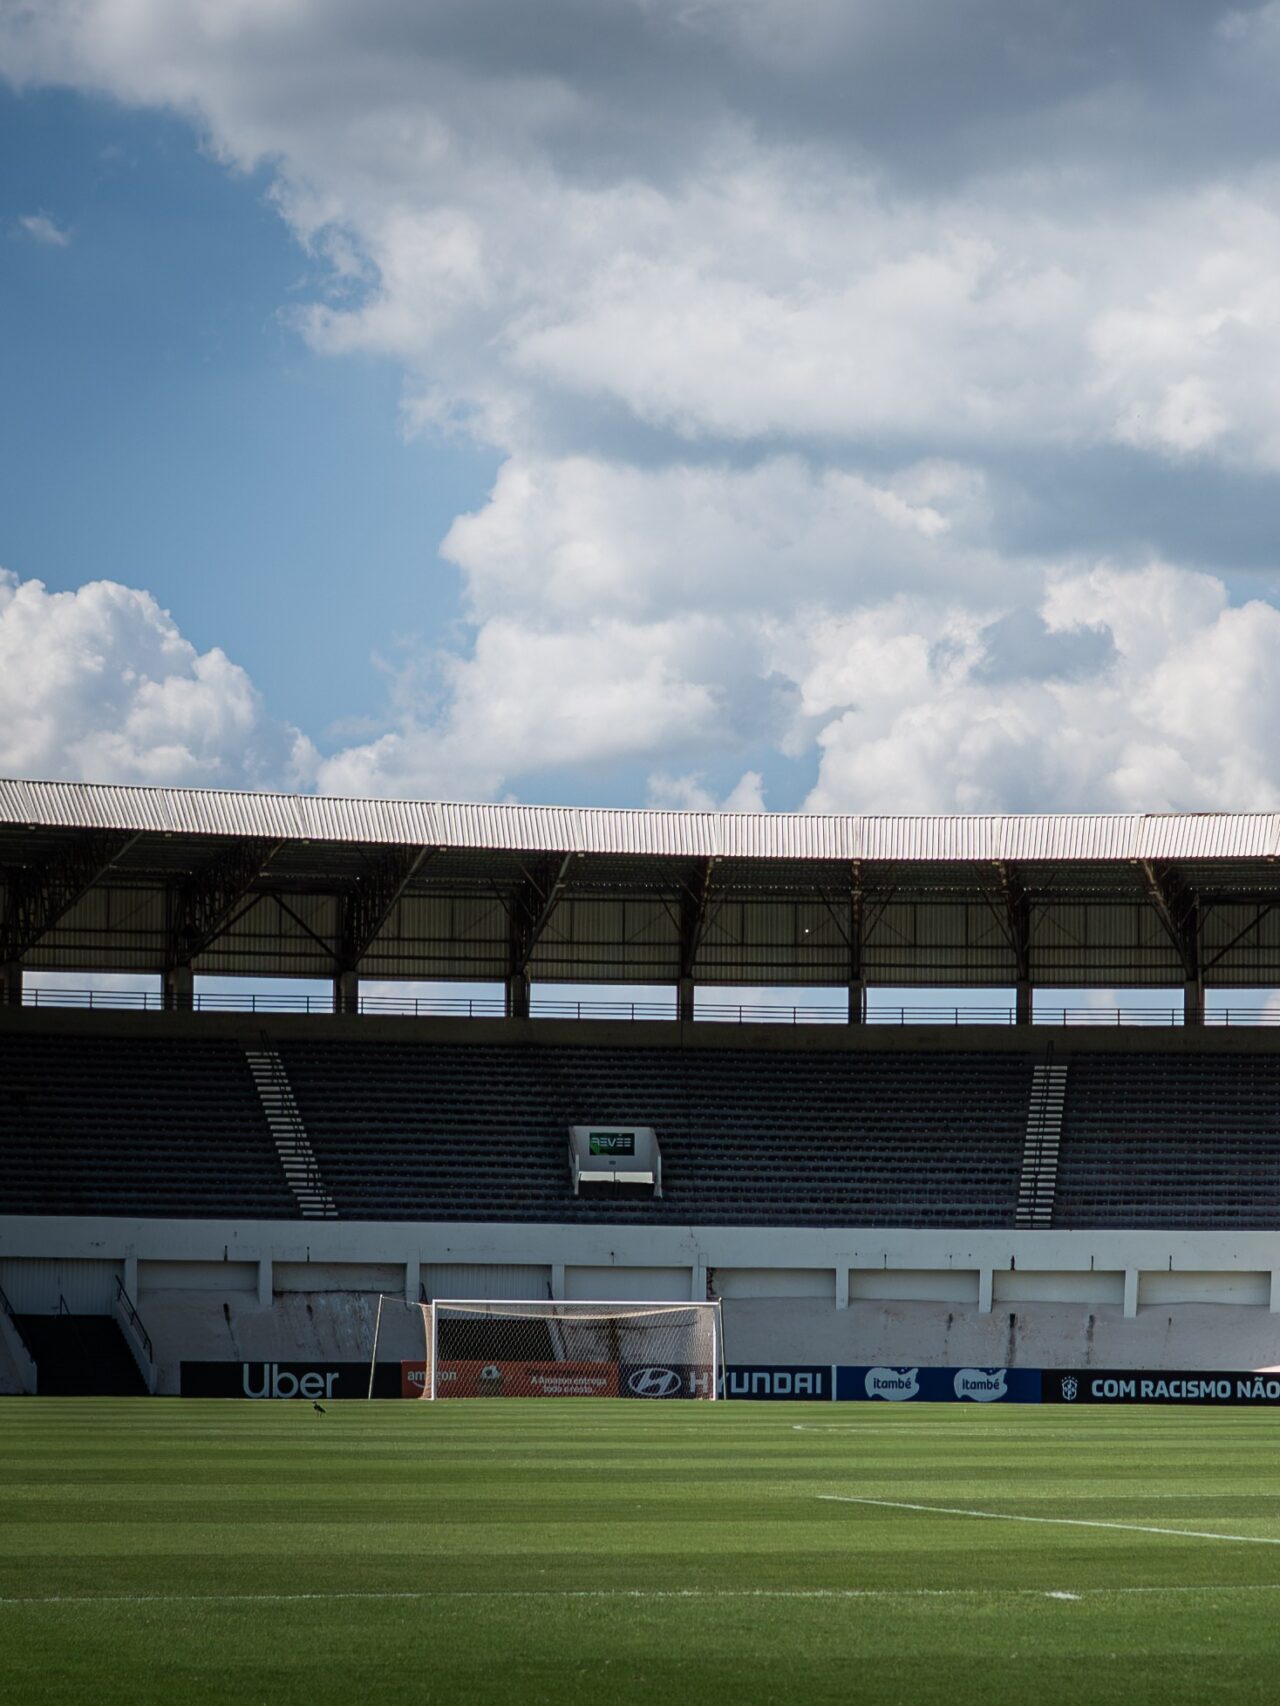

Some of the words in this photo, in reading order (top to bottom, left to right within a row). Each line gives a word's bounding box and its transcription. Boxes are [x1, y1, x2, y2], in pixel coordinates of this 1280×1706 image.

[243, 1363, 339, 1398] Uber
[407, 1370, 457, 1381] amzon
[690, 1372, 822, 1394] HYUNDAI
[873, 1377, 912, 1390] itambé
[962, 1378, 1000, 1391] itambé
[1091, 1379, 1136, 1398] COM
[1141, 1380, 1231, 1398] RACISMO
[1237, 1376, 1280, 1399] NÃO
